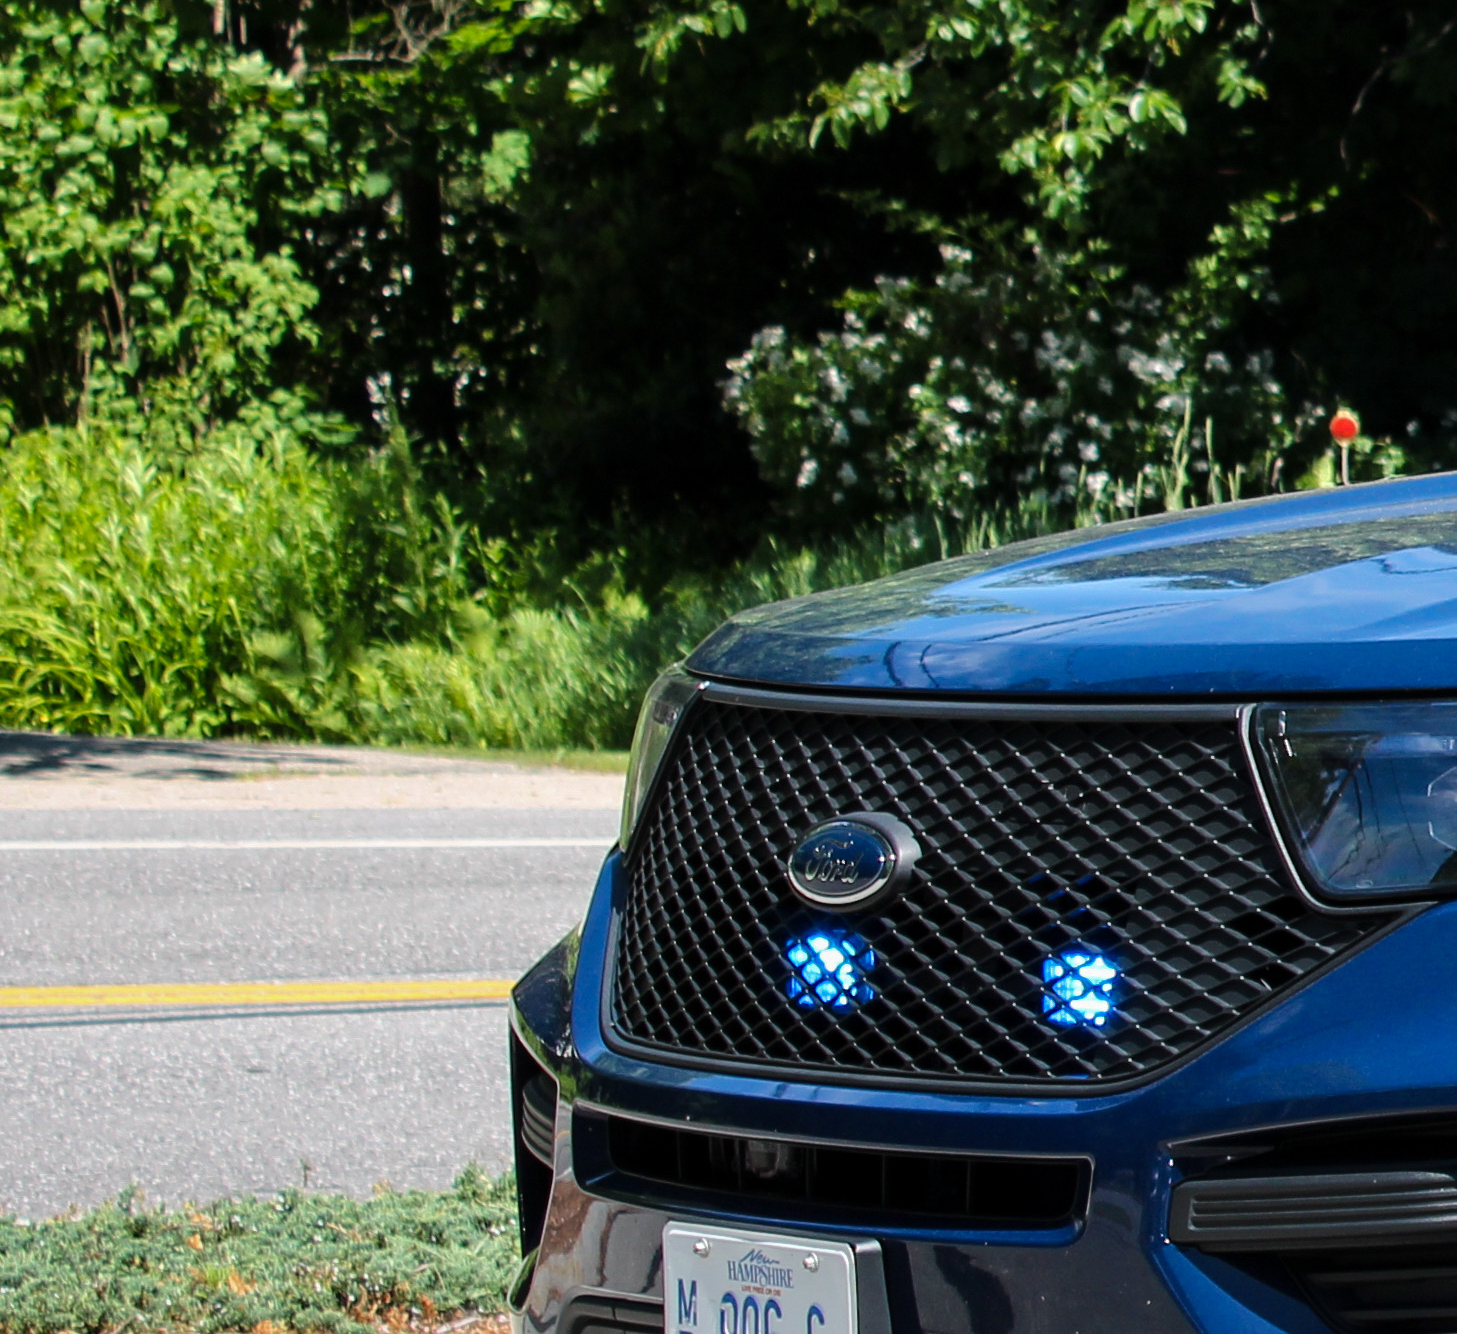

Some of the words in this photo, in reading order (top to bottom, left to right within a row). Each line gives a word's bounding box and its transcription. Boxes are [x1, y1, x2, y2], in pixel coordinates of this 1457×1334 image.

[805, 837, 866, 884] Ford
[739, 1248, 780, 1265] New
[726, 1260, 795, 1289] HAMPSHIRE
